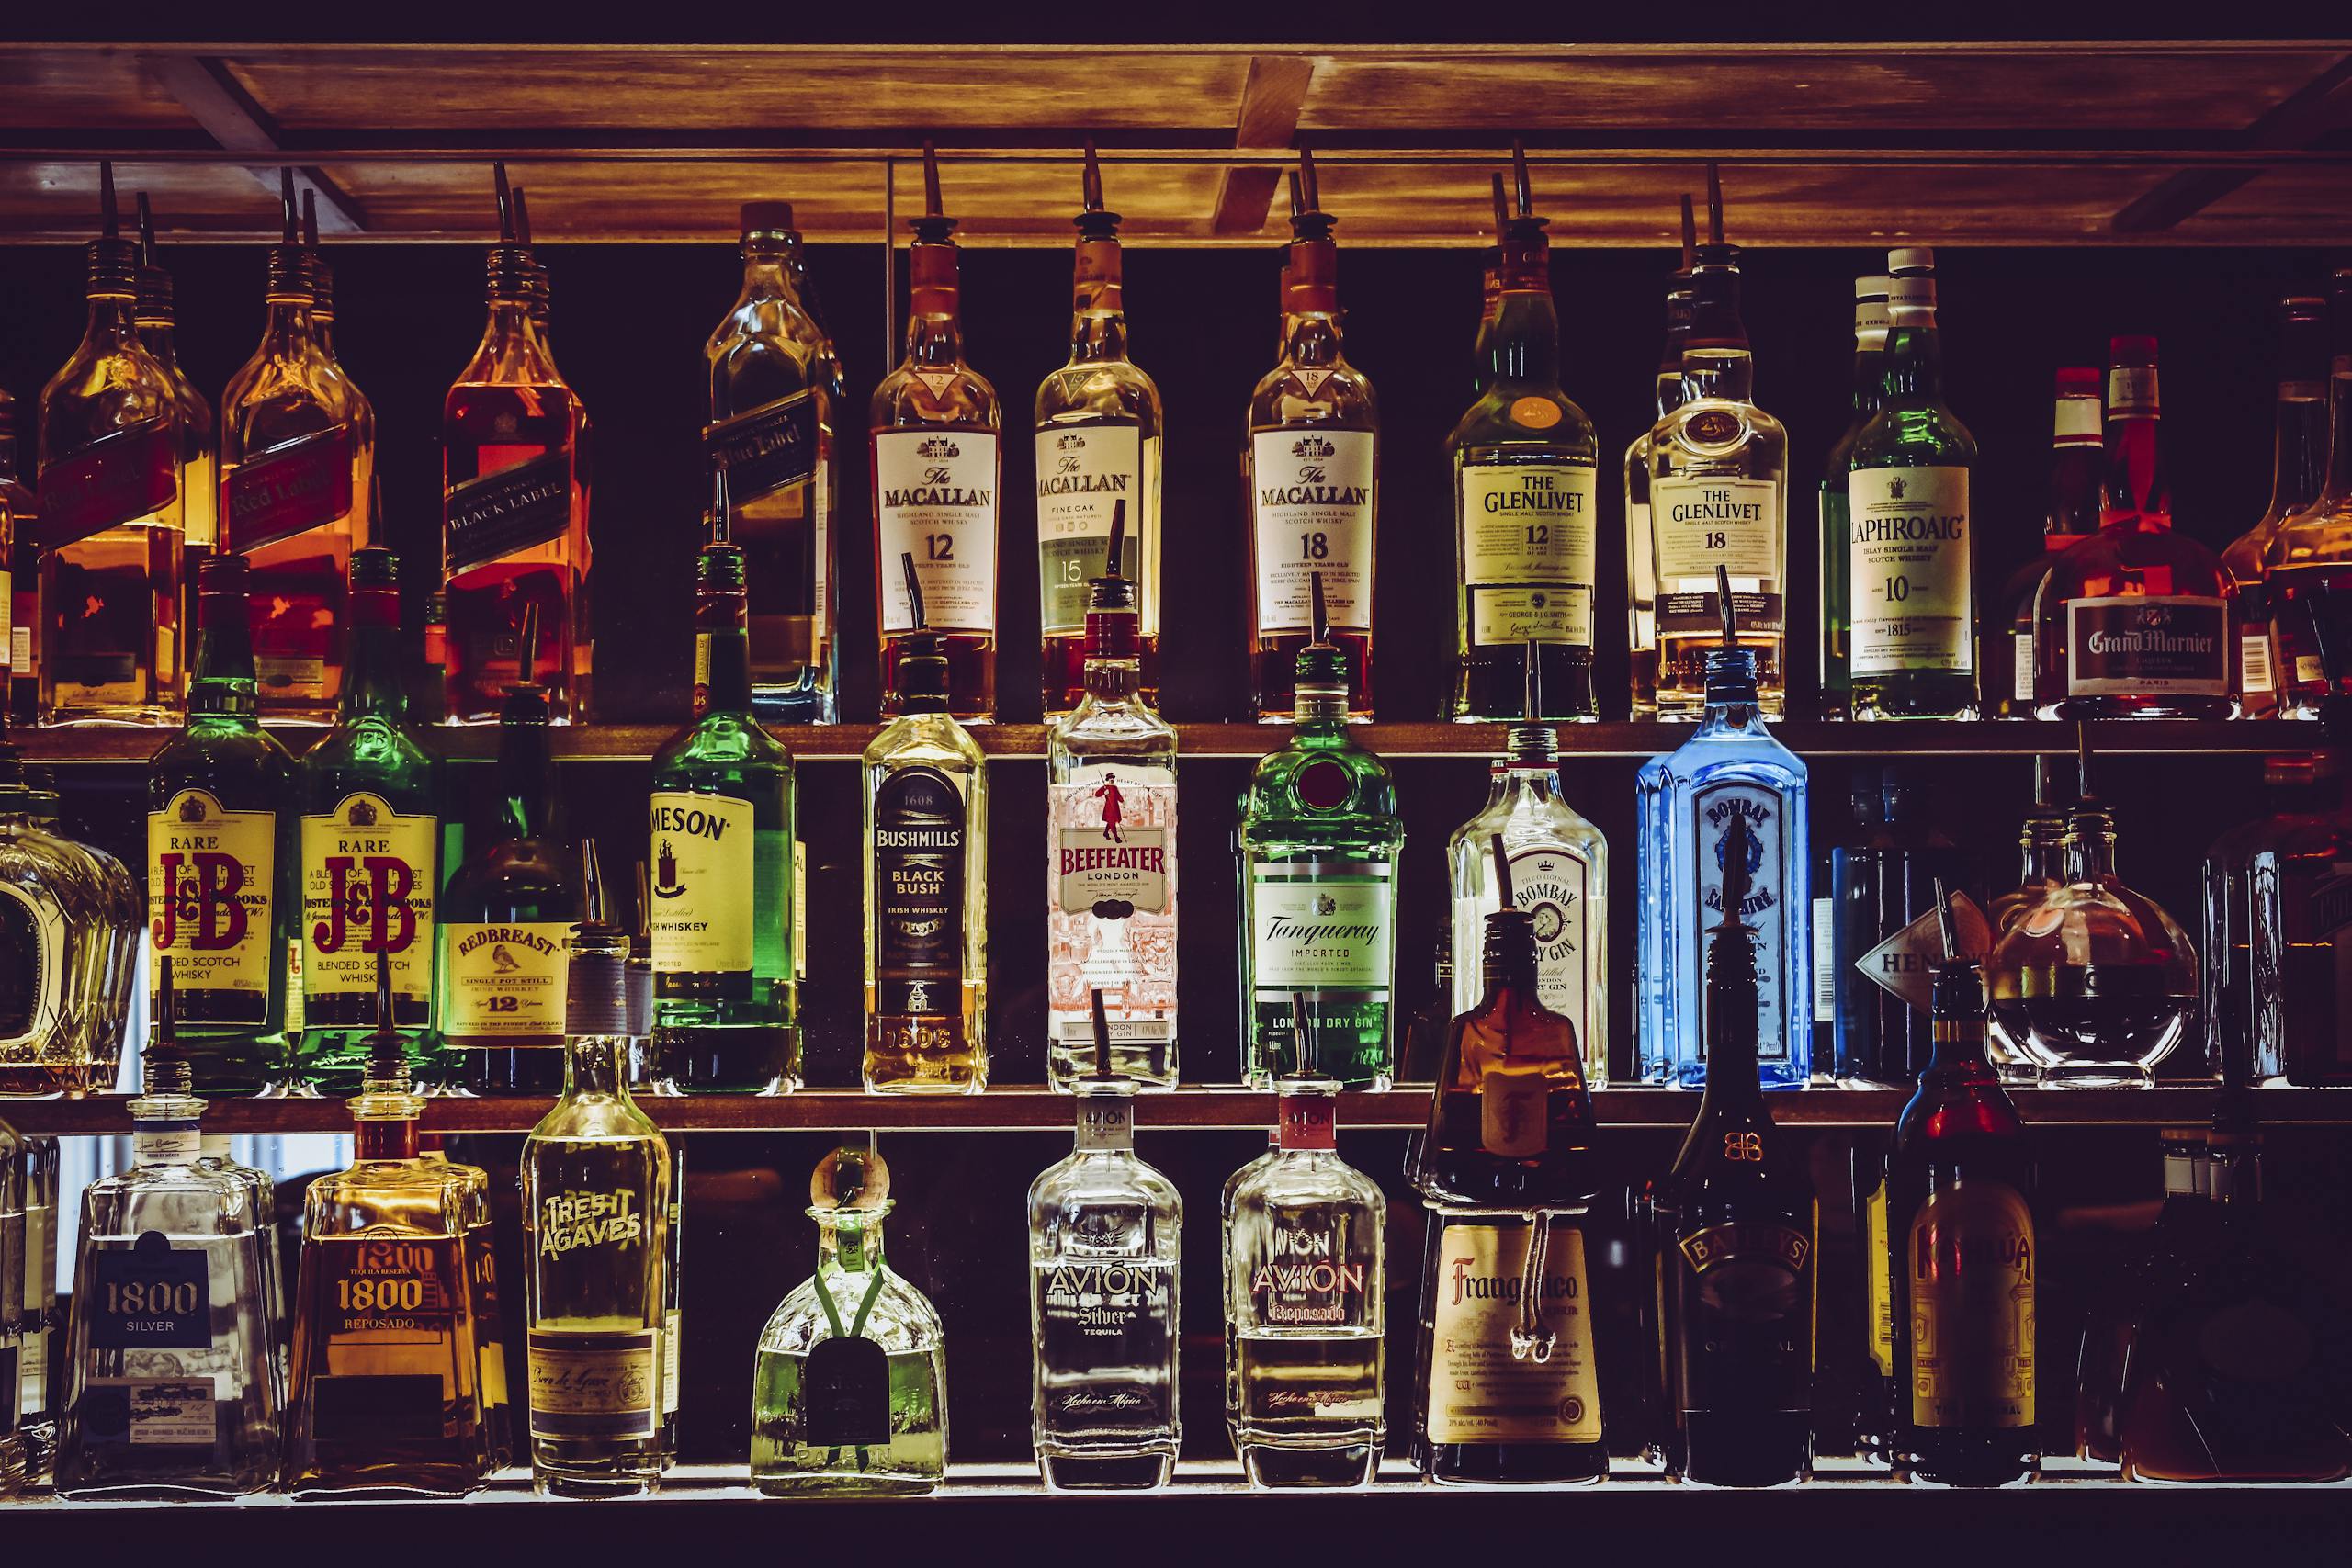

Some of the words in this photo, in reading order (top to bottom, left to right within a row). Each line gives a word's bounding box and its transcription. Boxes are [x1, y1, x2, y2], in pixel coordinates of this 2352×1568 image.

[930, 374, 944, 385] 12
[1057, 456, 1081, 475] The
[921, 467, 951, 485] The
[1295, 466, 1326, 484] The
[1521, 476, 1554, 490] THE
[884, 487, 991, 508] MACALLAN
[1261, 486, 1369, 507] MACALLAN
[1485, 492, 1583, 513] GLENLIVET
[1702, 490, 1731, 502] THE
[450, 505, 505, 531] BLACK
[510, 483, 562, 510] LABEL
[1074, 504, 1094, 513] OAK
[1672, 504, 1761, 522] GLENLIVET
[1526, 525, 1549, 544] 12
[1705, 532, 1726, 548] 18
[926, 533, 954, 560] 12
[1301, 532, 1329, 560] 18
[1868, 556, 1895, 564] SCOTCH
[1062, 560, 1082, 581] 15
[1885, 575, 1909, 602] 10
[1886, 624, 1911, 637] 1815
[2088, 629, 2143, 655] Grand
[2143, 630, 2212, 655] Marnier
[905, 795, 933, 806] 1608
[1705, 798, 1771, 828] BOMBAY
[651, 807, 727, 841] MESON
[171, 837, 219, 850] RARE
[338, 840, 390, 853] RARE
[877, 830, 960, 847] BUSHMILLS
[1061, 847, 1166, 876] BEEFEATER
[310, 881, 325, 890] OLD
[892, 871, 944, 882] BLACK
[1087, 873, 1139, 881] LONDON
[1522, 875, 1535, 885] THE
[1536, 874, 1571, 886] ORIGINAL
[897, 883, 940, 894] BUSH
[1516, 883, 1577, 909] BOMBAY
[153, 852, 248, 951] J&B
[313, 856, 416, 954] J&B
[662, 922, 708, 931] WHISKEY
[1267, 916, 1379, 946] Tanqueray
[458, 928, 556, 956] REDBREAST
[1550, 940, 1577, 962] GIN
[193, 957, 240, 967] SCOTCH
[1291, 949, 1350, 957] IMPORTED
[318, 961, 359, 970] BLENDED
[365, 960, 410, 970] SCTCH
[340, 974, 377, 983] WHISK
[488, 996, 518, 1012] 12
[1273, 1018, 1320, 1028] LONON
[1327, 1018, 1350, 1028] DRY
[1355, 1018, 1373, 1028] GIN
[540, 1213, 641, 1261] AGAVES
[1047, 1260, 1159, 1295] AVIÓN
[1252, 1260, 1364, 1293] AVIÓN
[1453, 1258, 1578, 1306] Frangico
[106, 1280, 198, 1315] 1800
[338, 1279, 423, 1310] 1800
[1078, 1306, 1126, 1325] Silver
[1271, 1303, 1346, 1325] Reposado
[126, 1321, 175, 1331] SILVER
[345, 1318, 415, 1329] REPOSADO
